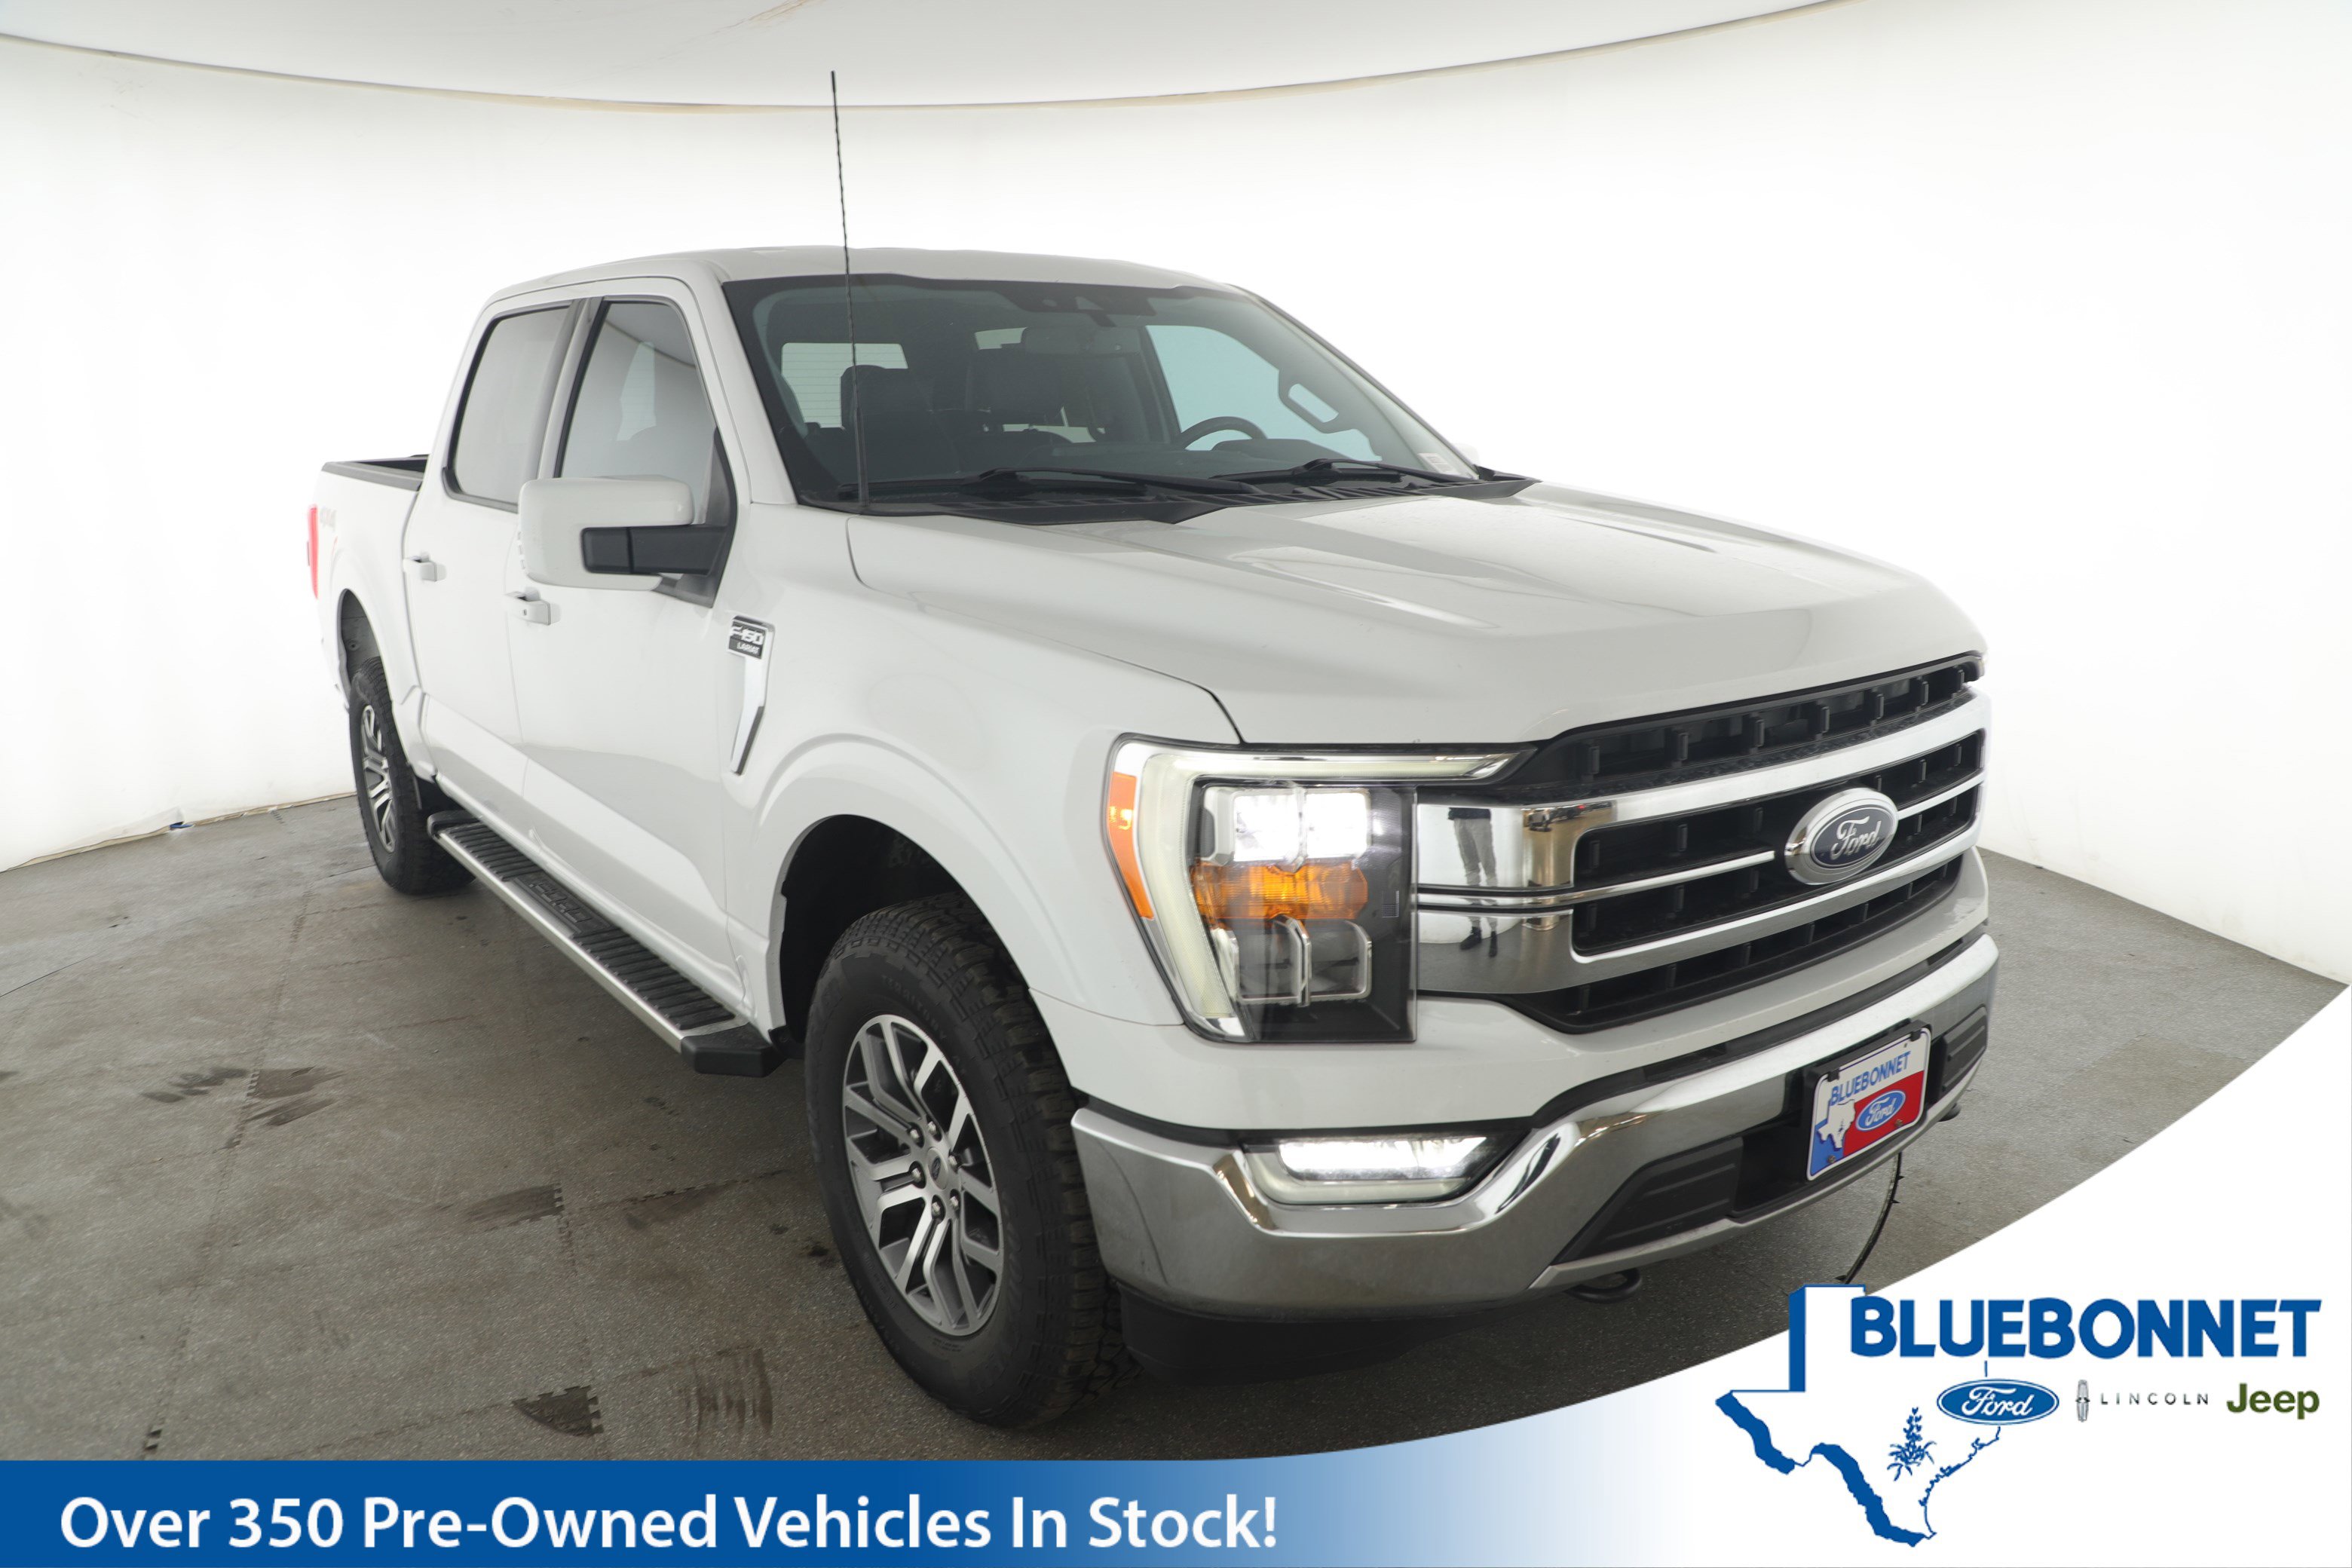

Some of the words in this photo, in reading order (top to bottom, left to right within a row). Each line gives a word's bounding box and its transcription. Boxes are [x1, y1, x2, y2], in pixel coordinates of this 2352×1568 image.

[1830, 815, 1882, 860] Ford
[1830, 1051, 1911, 1106] BLUEBONNET
[1866, 1098, 1896, 1126] Ford
